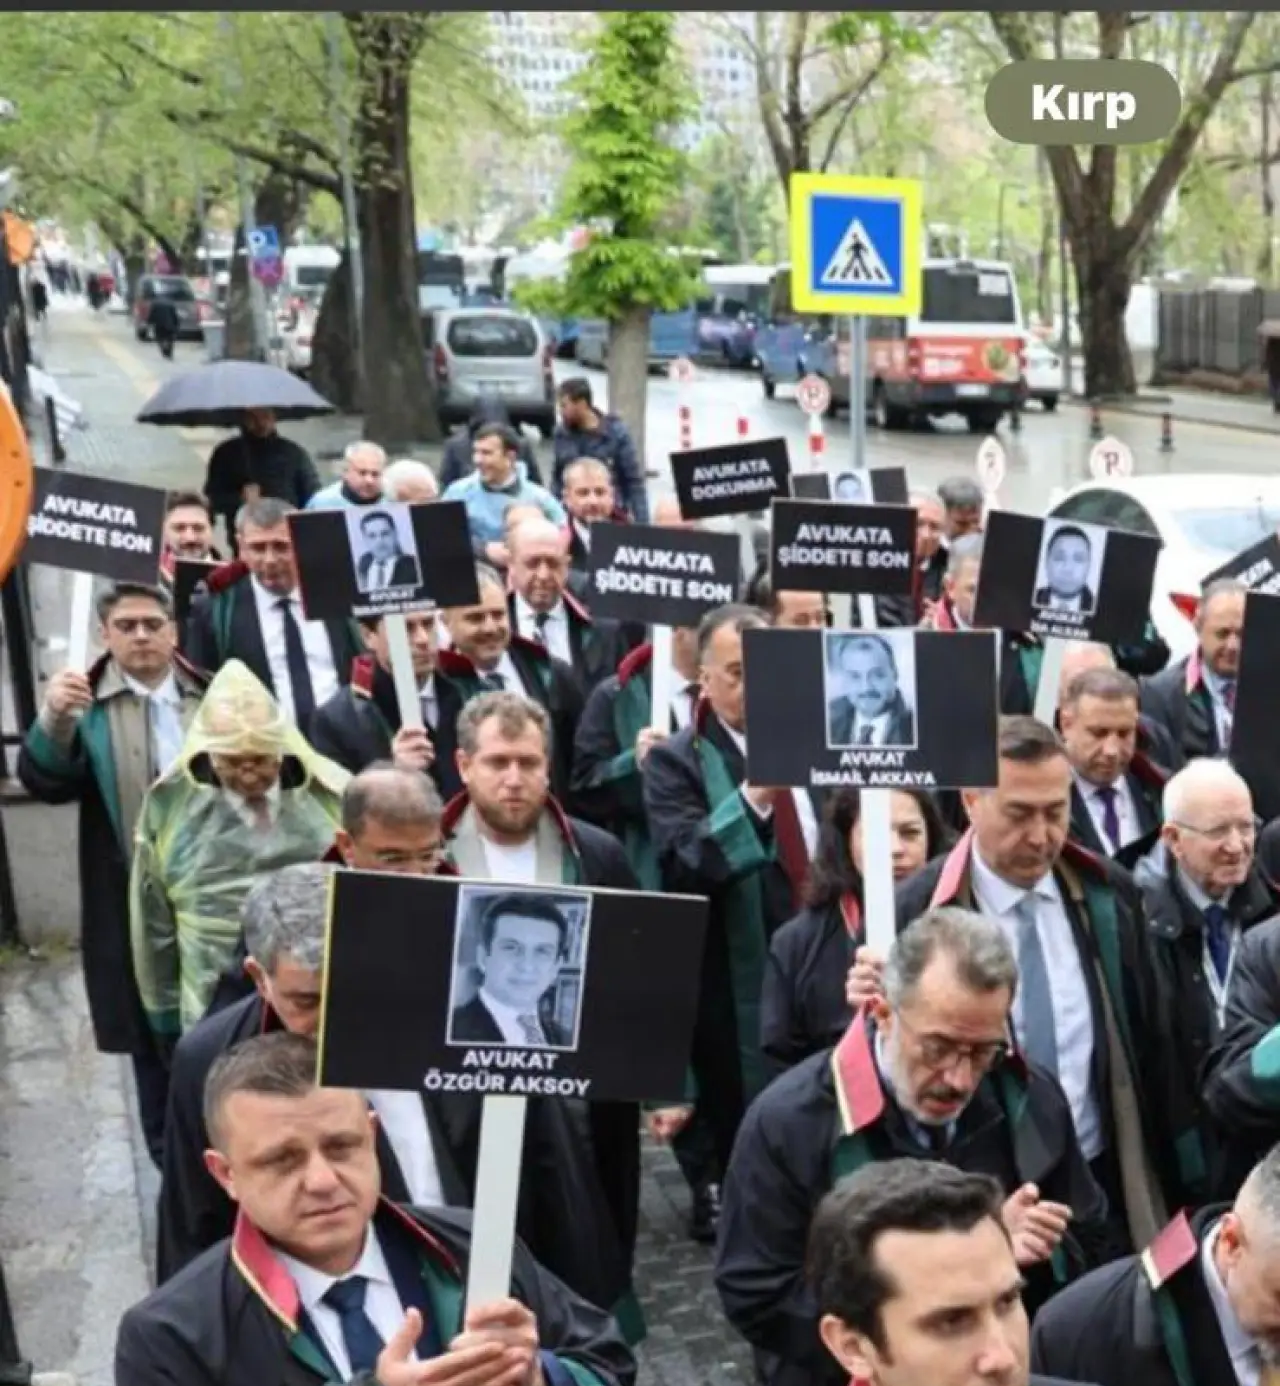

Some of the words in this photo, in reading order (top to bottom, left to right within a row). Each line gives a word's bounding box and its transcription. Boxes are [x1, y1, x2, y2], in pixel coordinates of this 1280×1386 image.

[692, 458, 772, 482] AVUKATA
[690, 475, 778, 501] DOKUNMA
[43, 494, 138, 528] AVUKATA
[27, 511, 107, 546] ŞİDDETE
[109, 528, 153, 554] SON
[795, 522, 893, 546] AVUKATA
[614, 545, 715, 576] AVUKATA
[777, 541, 863, 568] ŞİDDETE
[866, 549, 910, 569] SON
[595, 564, 683, 598] ŞİDDETE
[686, 579, 732, 603] SON
[840, 751, 907, 768] AVUKAT
[809, 766, 866, 786] İSMAİL
[868, 770, 938, 786] AKKAYA
[461, 1049, 559, 1070] AVUKAT
[423, 1067, 506, 1092] ÖZGÜR
[509, 1075, 592, 1098] AKSOY
